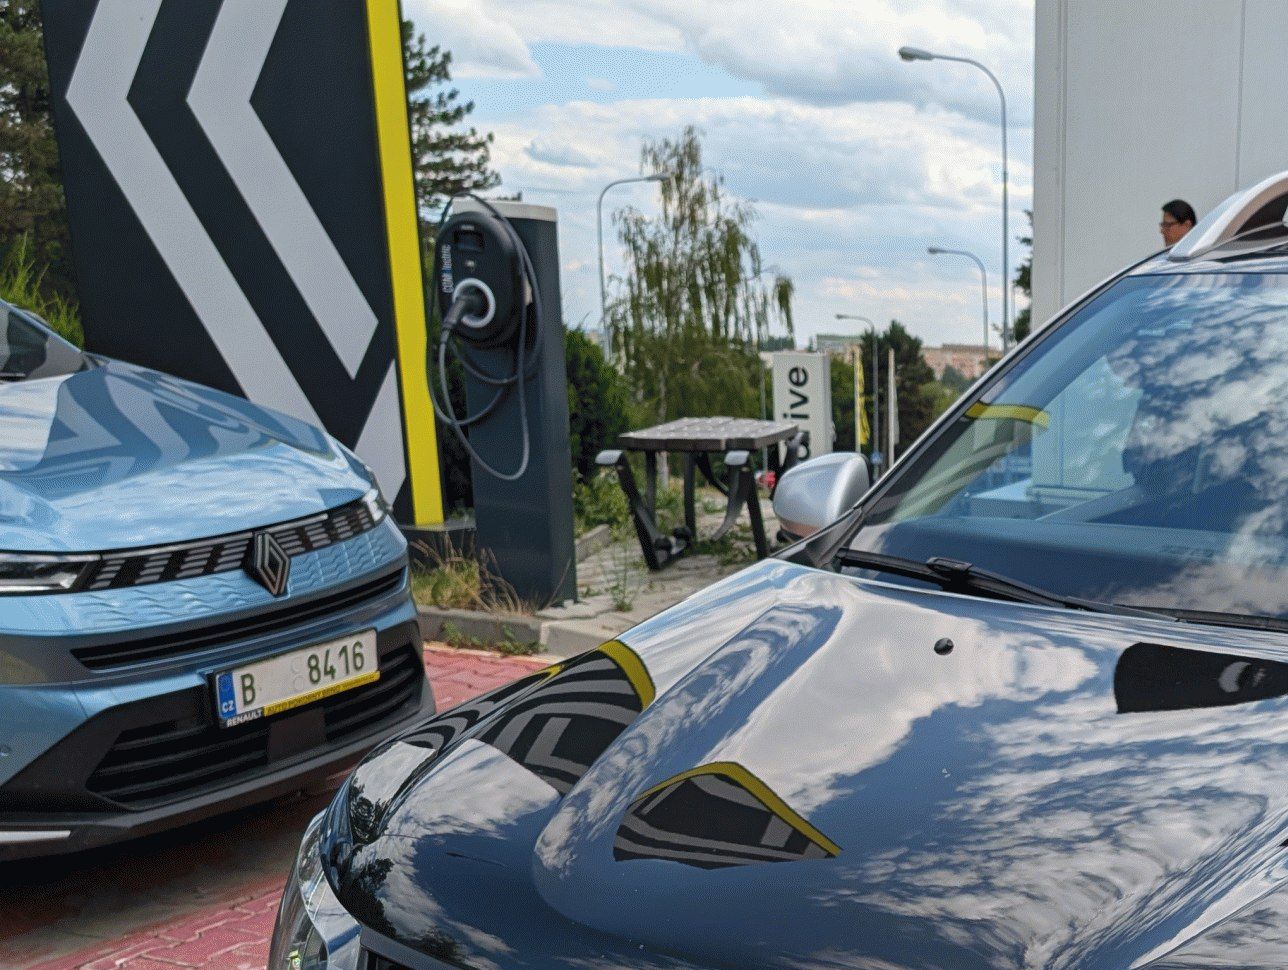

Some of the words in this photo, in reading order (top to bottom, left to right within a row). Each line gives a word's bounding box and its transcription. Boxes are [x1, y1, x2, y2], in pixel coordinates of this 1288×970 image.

[307, 640, 365, 685] 8416
[221, 700, 235, 713] CZ
[226, 707, 263, 728] RENAULT
